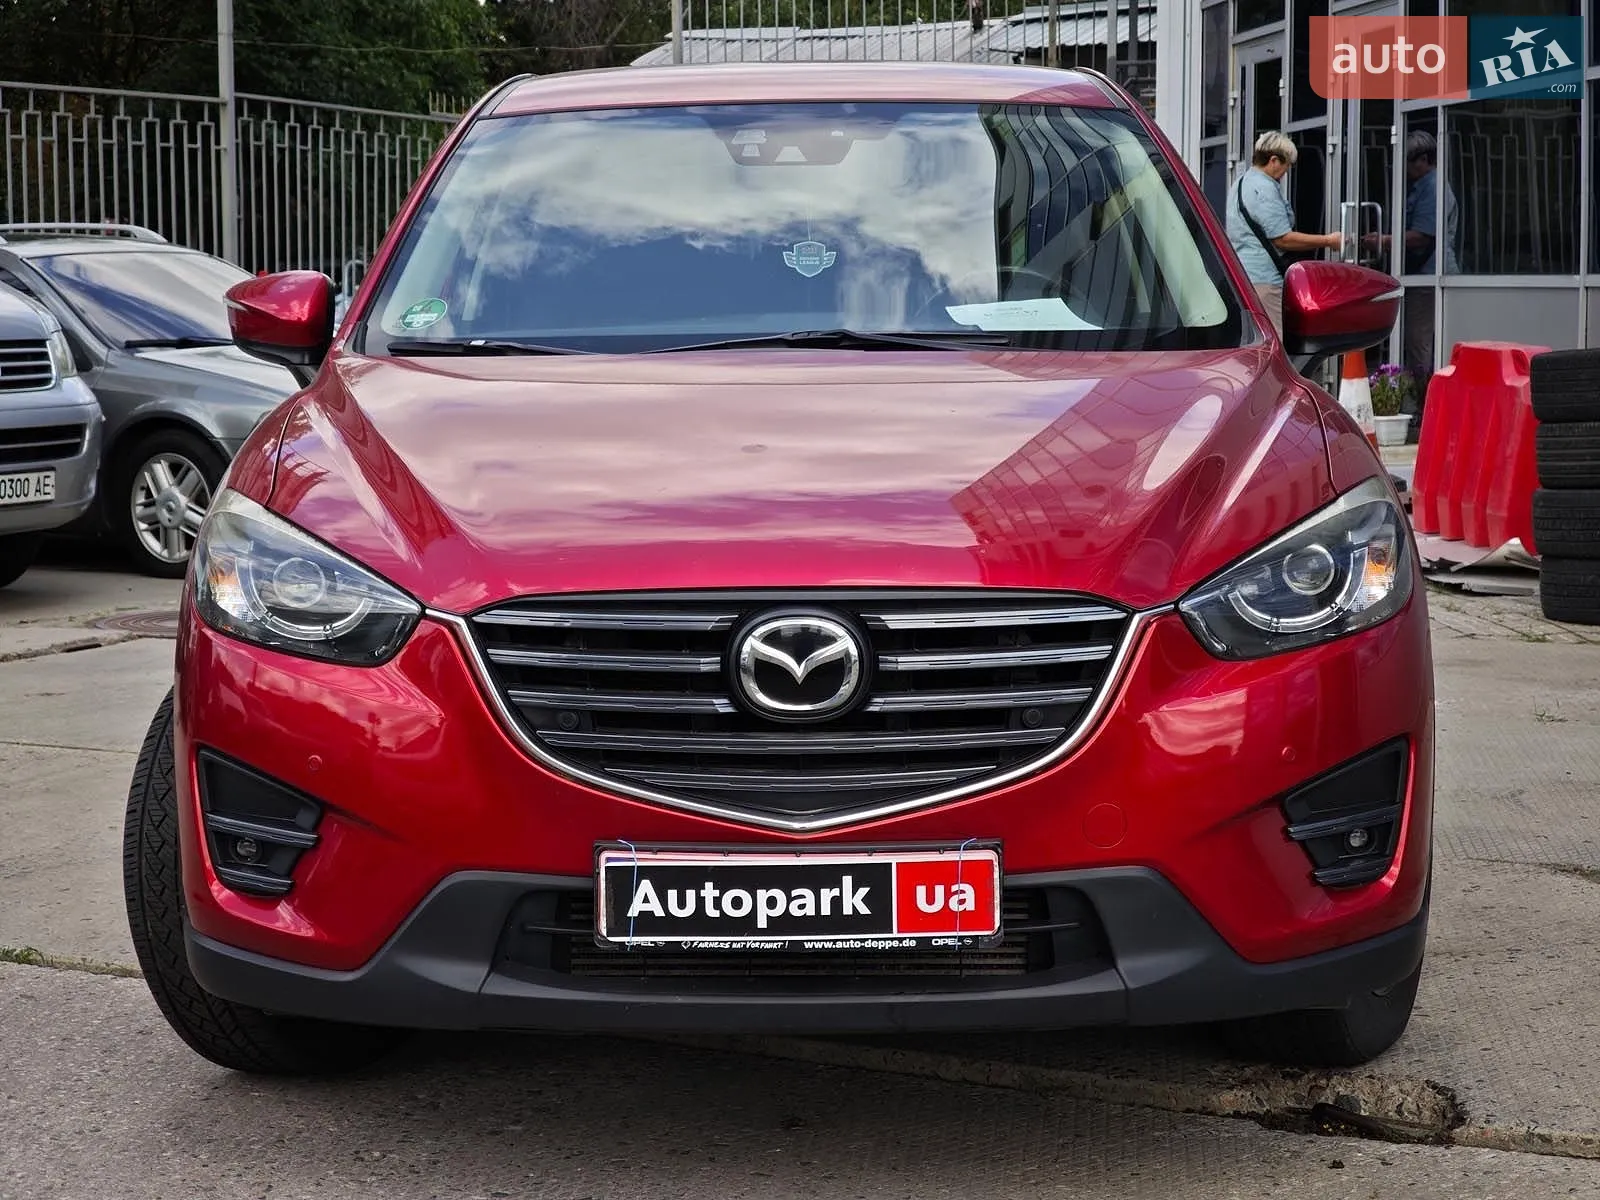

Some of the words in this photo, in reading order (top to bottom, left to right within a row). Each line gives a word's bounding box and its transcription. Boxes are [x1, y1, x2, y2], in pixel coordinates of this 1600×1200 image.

[34, 475, 51, 497] AE
[627, 875, 873, 929] Autopark
[914, 883, 976, 913] ua
[804, 938, 917, 950] www.auto-deppe.de
[931, 938, 962, 946] OPEL
